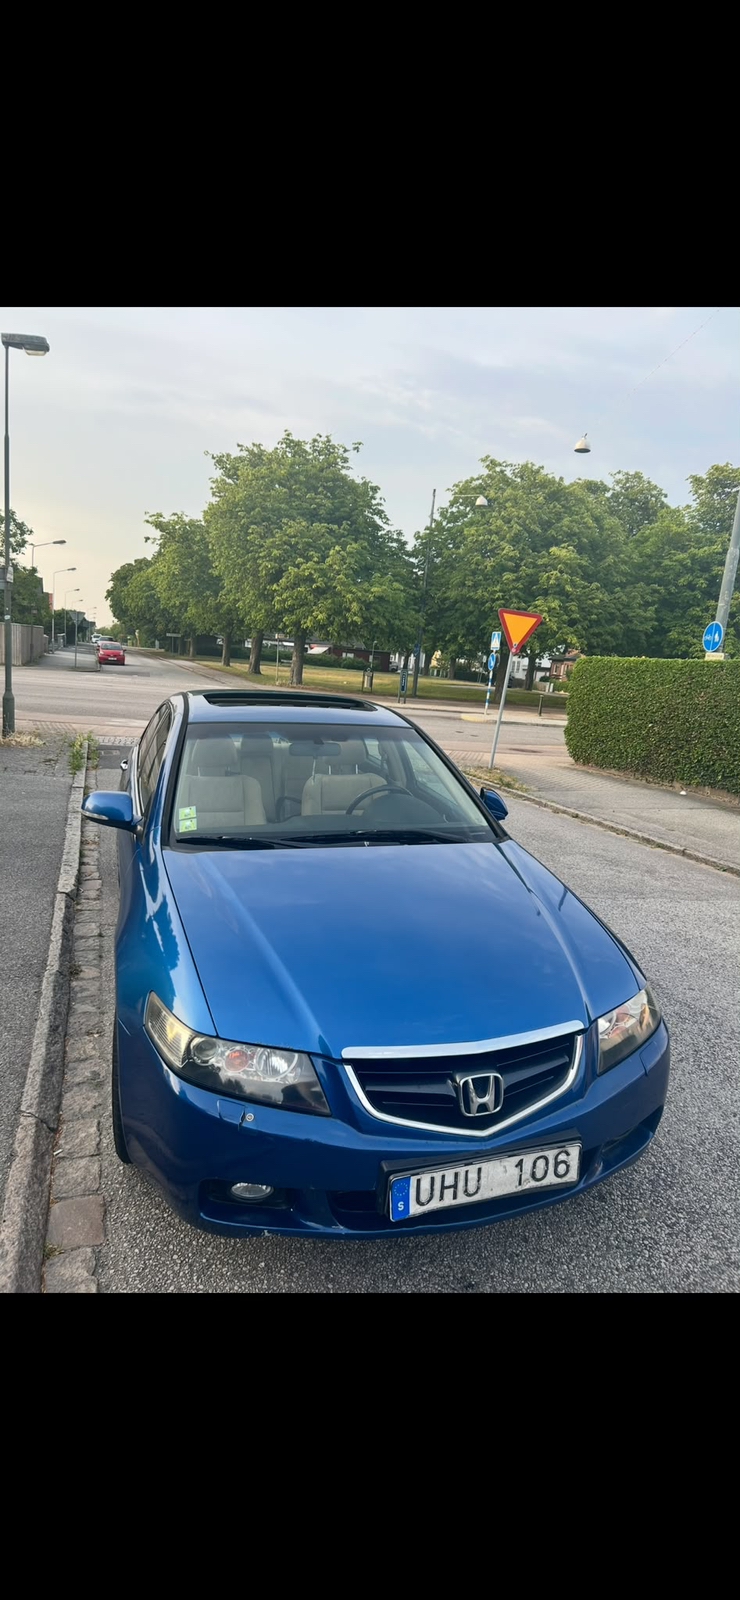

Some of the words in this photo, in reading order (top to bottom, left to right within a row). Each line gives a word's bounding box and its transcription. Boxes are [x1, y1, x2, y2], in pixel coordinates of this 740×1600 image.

[415, 1167, 482, 1207] UHU
[514, 1150, 571, 1187] 106
[397, 1201, 405, 1211] S
